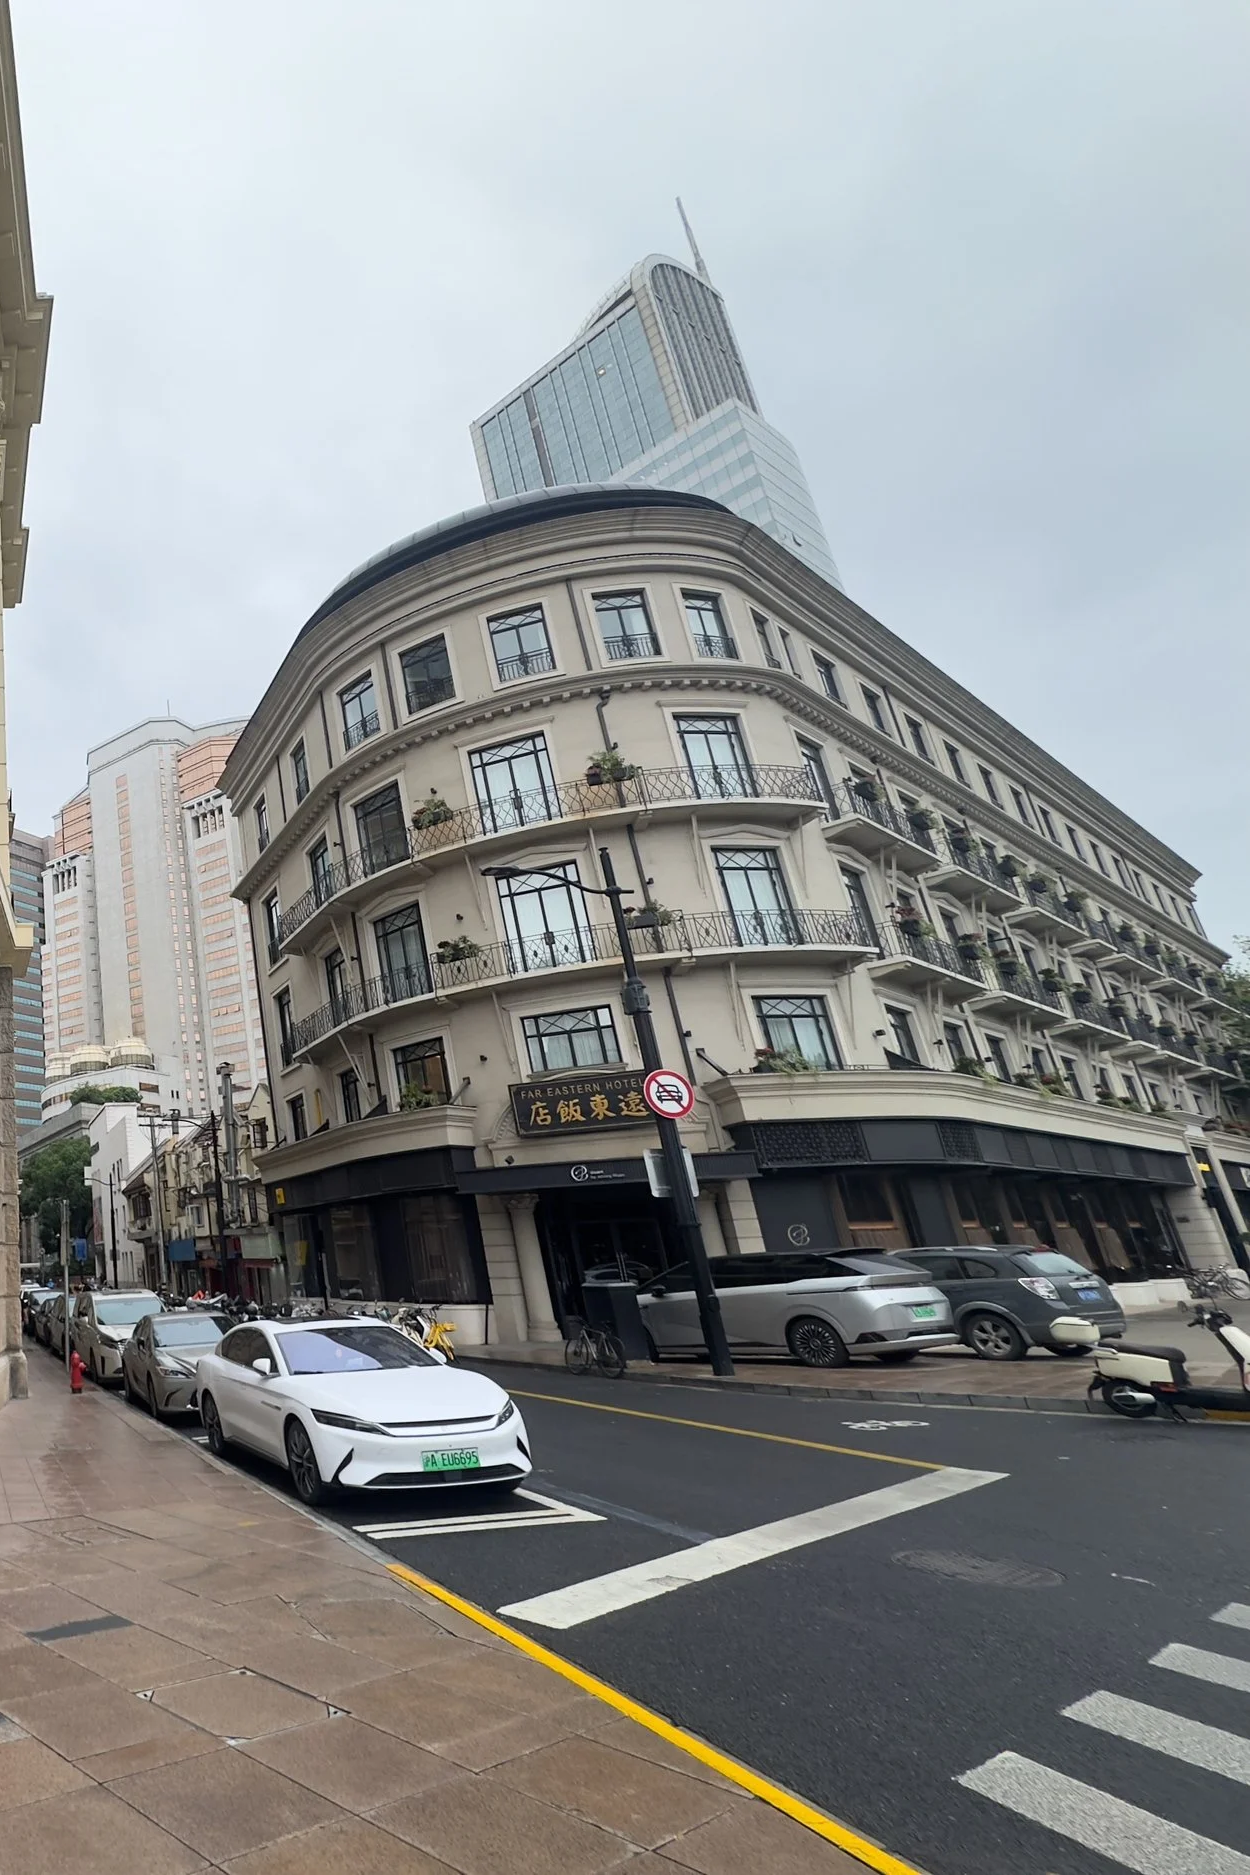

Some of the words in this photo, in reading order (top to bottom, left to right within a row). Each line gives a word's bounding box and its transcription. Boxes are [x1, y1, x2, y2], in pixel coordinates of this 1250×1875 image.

[520, 1090, 542, 1099] FAR
[547, 1083, 600, 1097] EASTERN
[606, 1078, 644, 1091] HOTEL
[441, 1450, 479, 1467] EU6695
